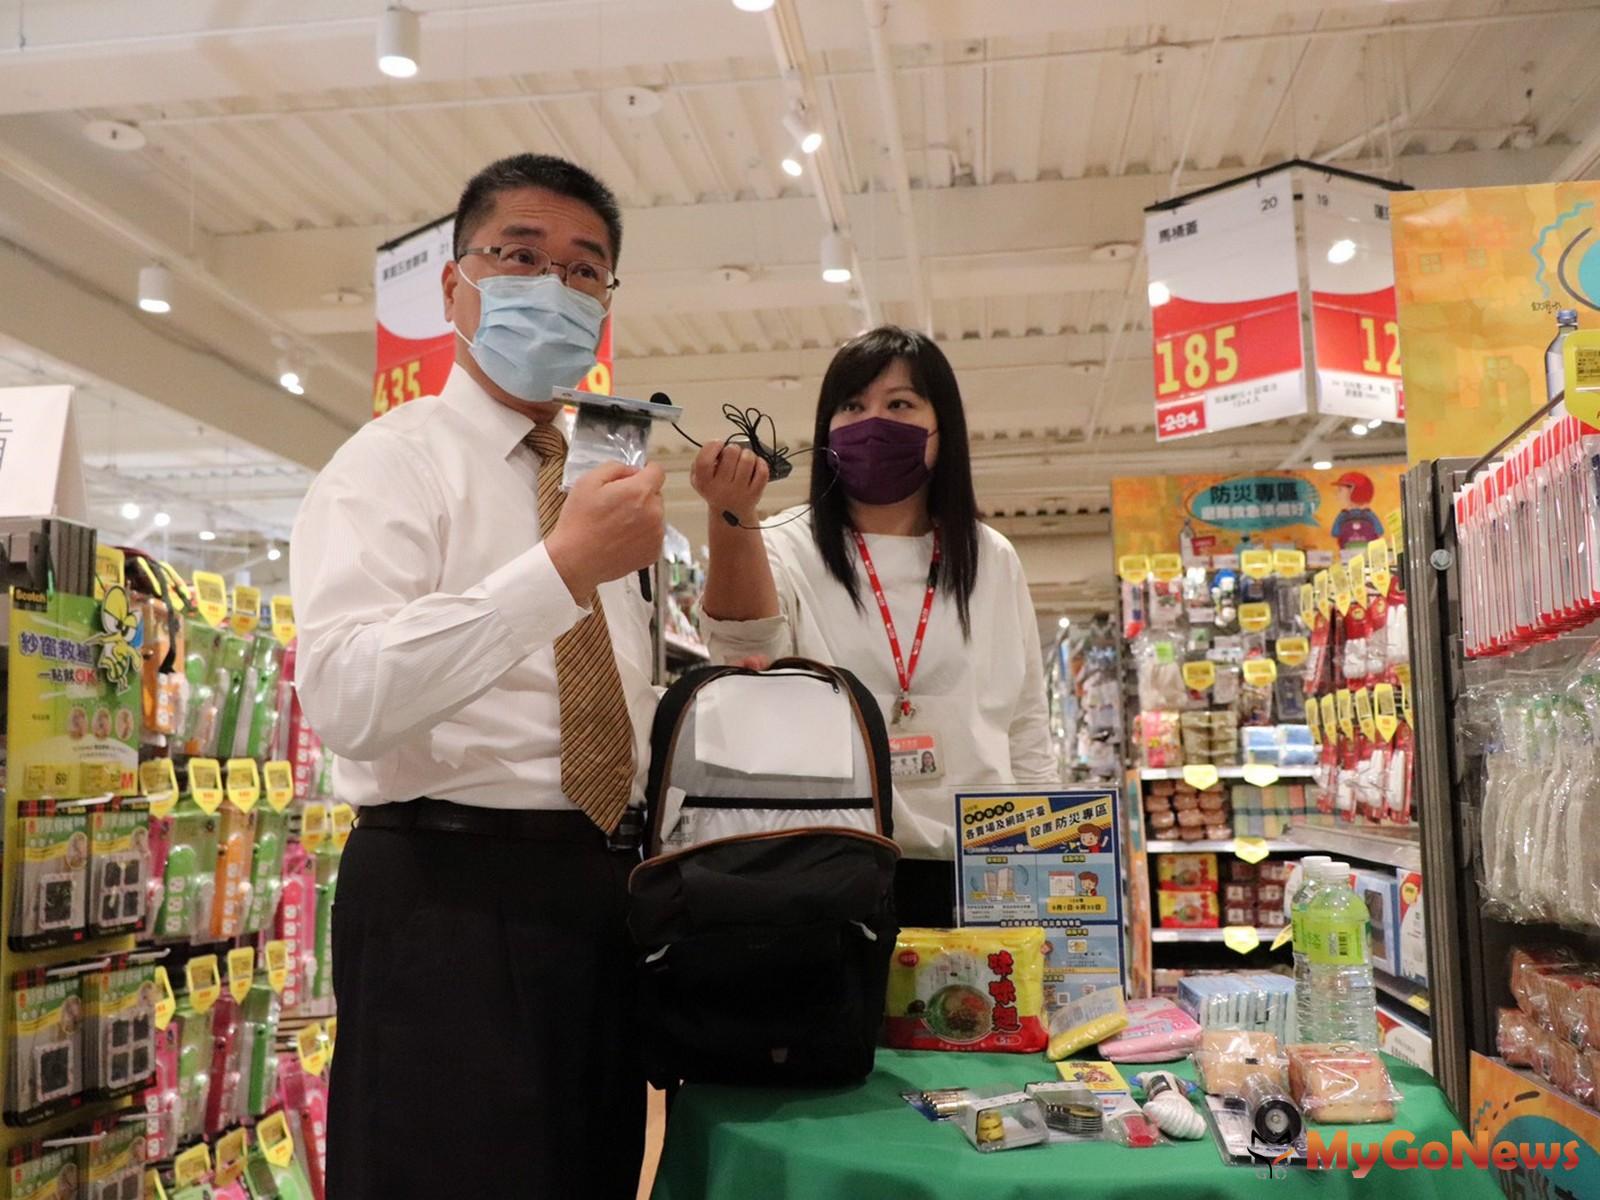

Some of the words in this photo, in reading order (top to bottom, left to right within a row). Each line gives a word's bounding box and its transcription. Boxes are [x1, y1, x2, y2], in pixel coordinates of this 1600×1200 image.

[1261, 196, 1278, 212] 20
[1156, 325, 1239, 395] 185
[1210, 482, 1298, 505] 防災專區
[15, 589, 48, 603] Scotch
